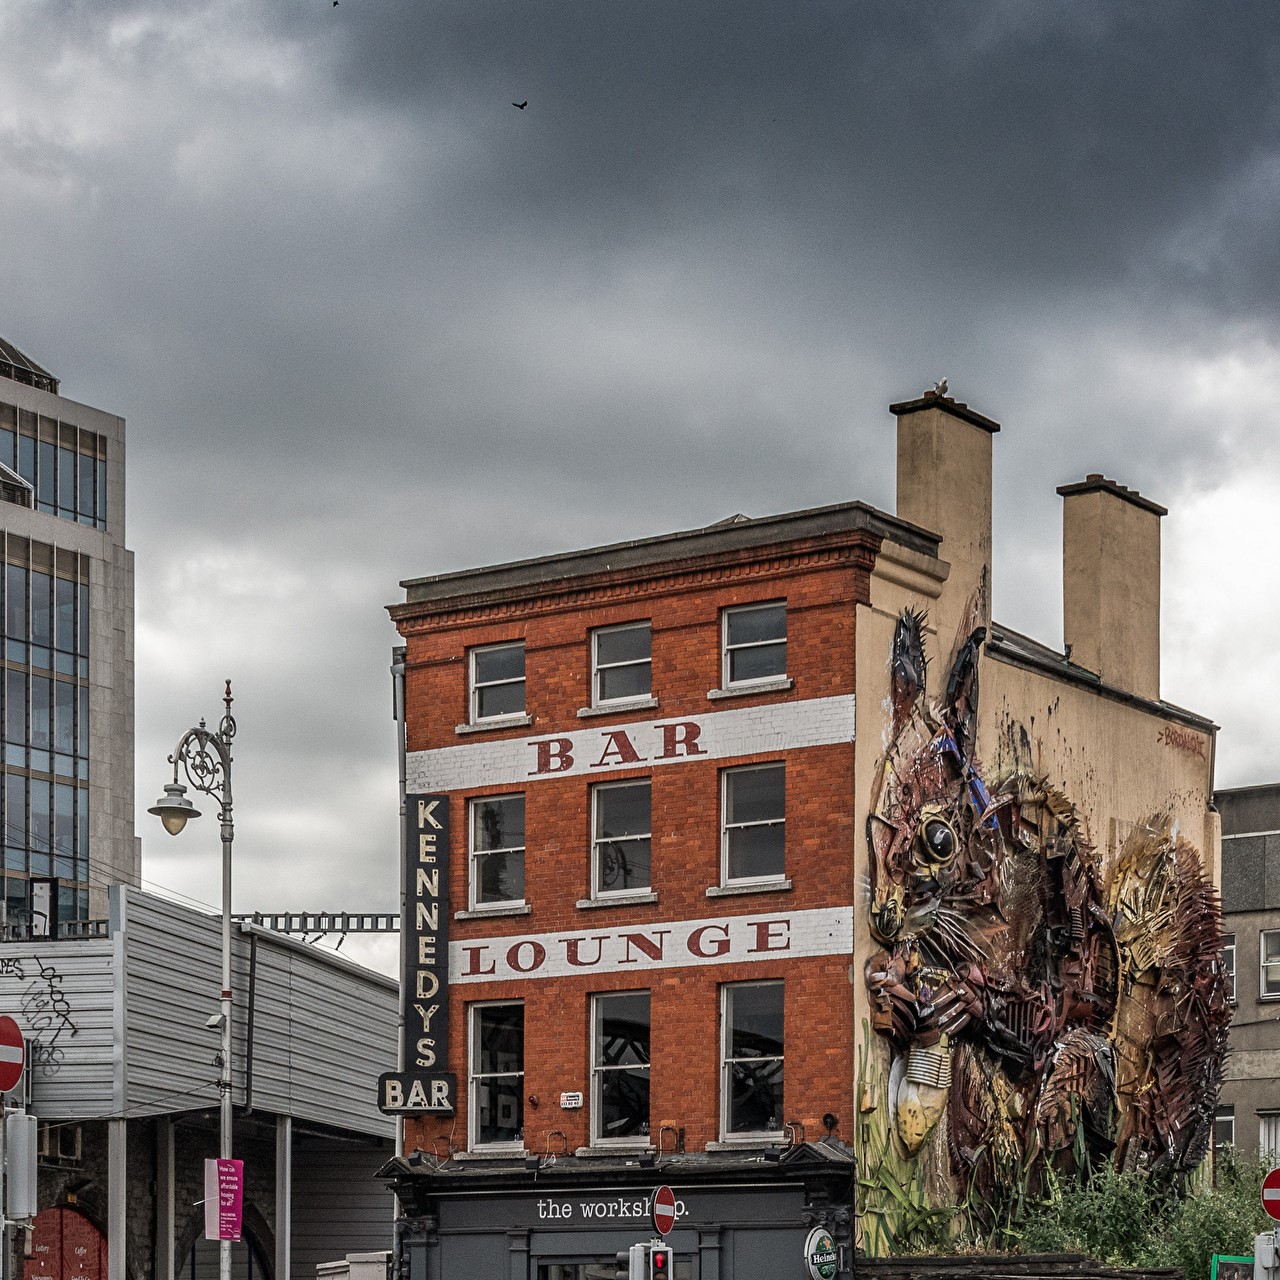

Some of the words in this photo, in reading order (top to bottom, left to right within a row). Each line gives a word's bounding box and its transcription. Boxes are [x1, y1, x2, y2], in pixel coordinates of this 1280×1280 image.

[527, 721, 708, 776] BAR
[414, 800, 443, 1067] KENNEDYS
[461, 919, 791, 976] LOUNGE
[386, 1079, 451, 1109] BAR
[537, 1199, 572, 1219] the
[580, 1197, 689, 1220] workshp.
[35, 1244, 49, 1254] Lottery
[74, 1247, 87, 1256] Coffee
